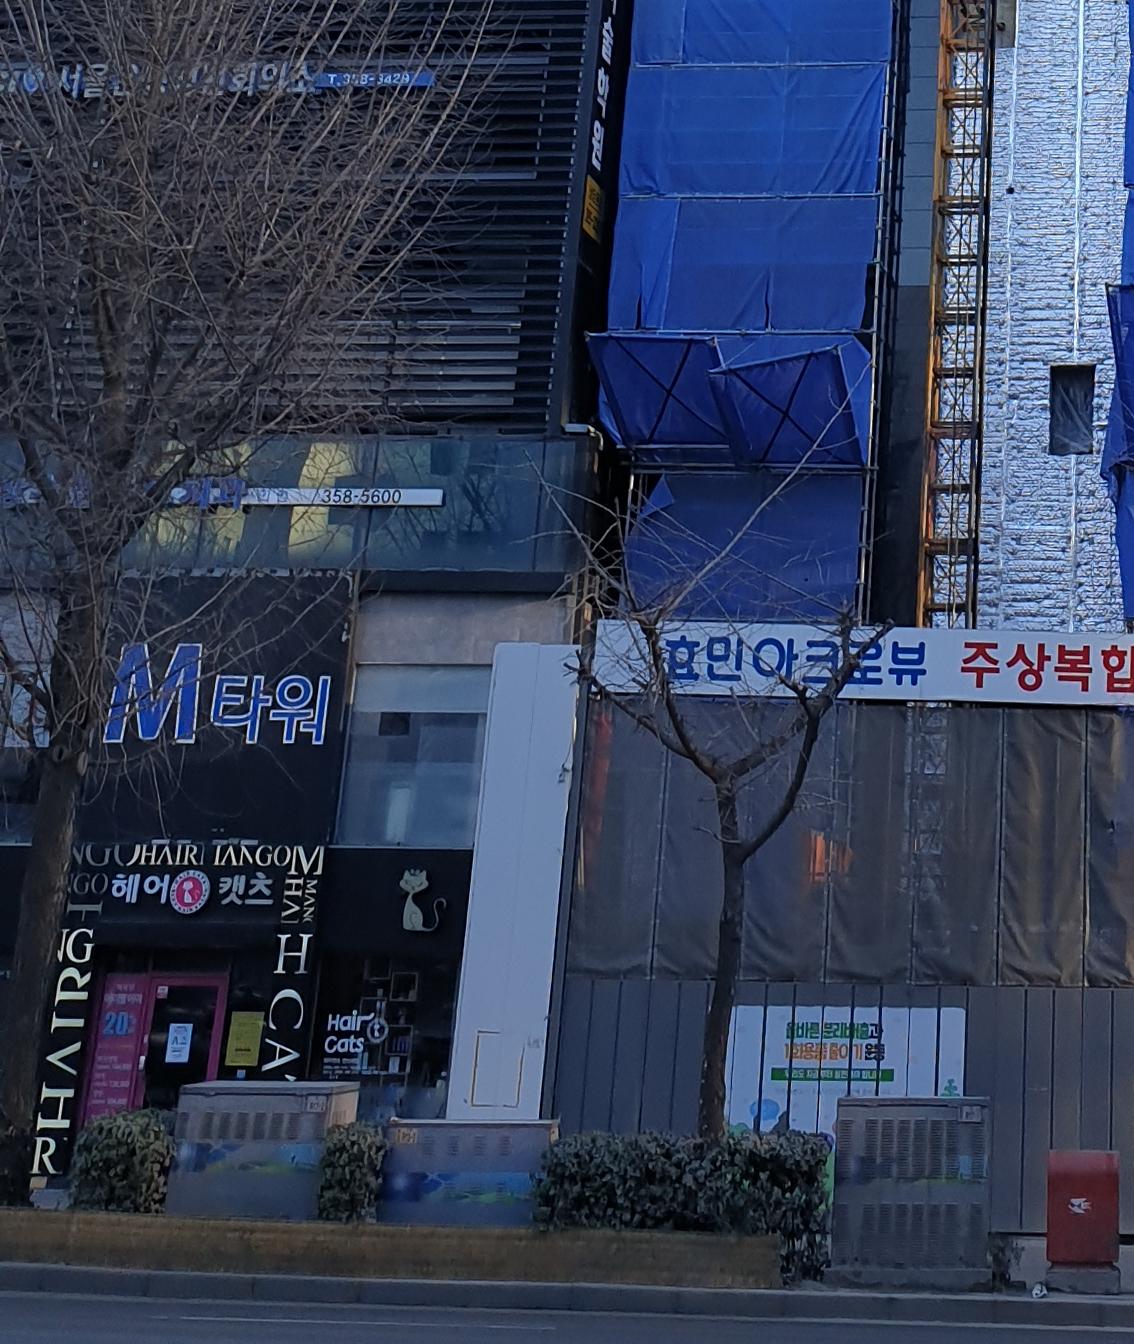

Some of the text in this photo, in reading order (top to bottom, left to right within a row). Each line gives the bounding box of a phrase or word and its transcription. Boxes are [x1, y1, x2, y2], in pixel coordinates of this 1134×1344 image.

[321, 489, 402, 504] 358-5600
[111, 873, 169, 904] 헤어
[219, 872, 274, 905] 캣츠
[327, 1010, 375, 1031] Hair
[324, 1035, 365, 1053] Cats
